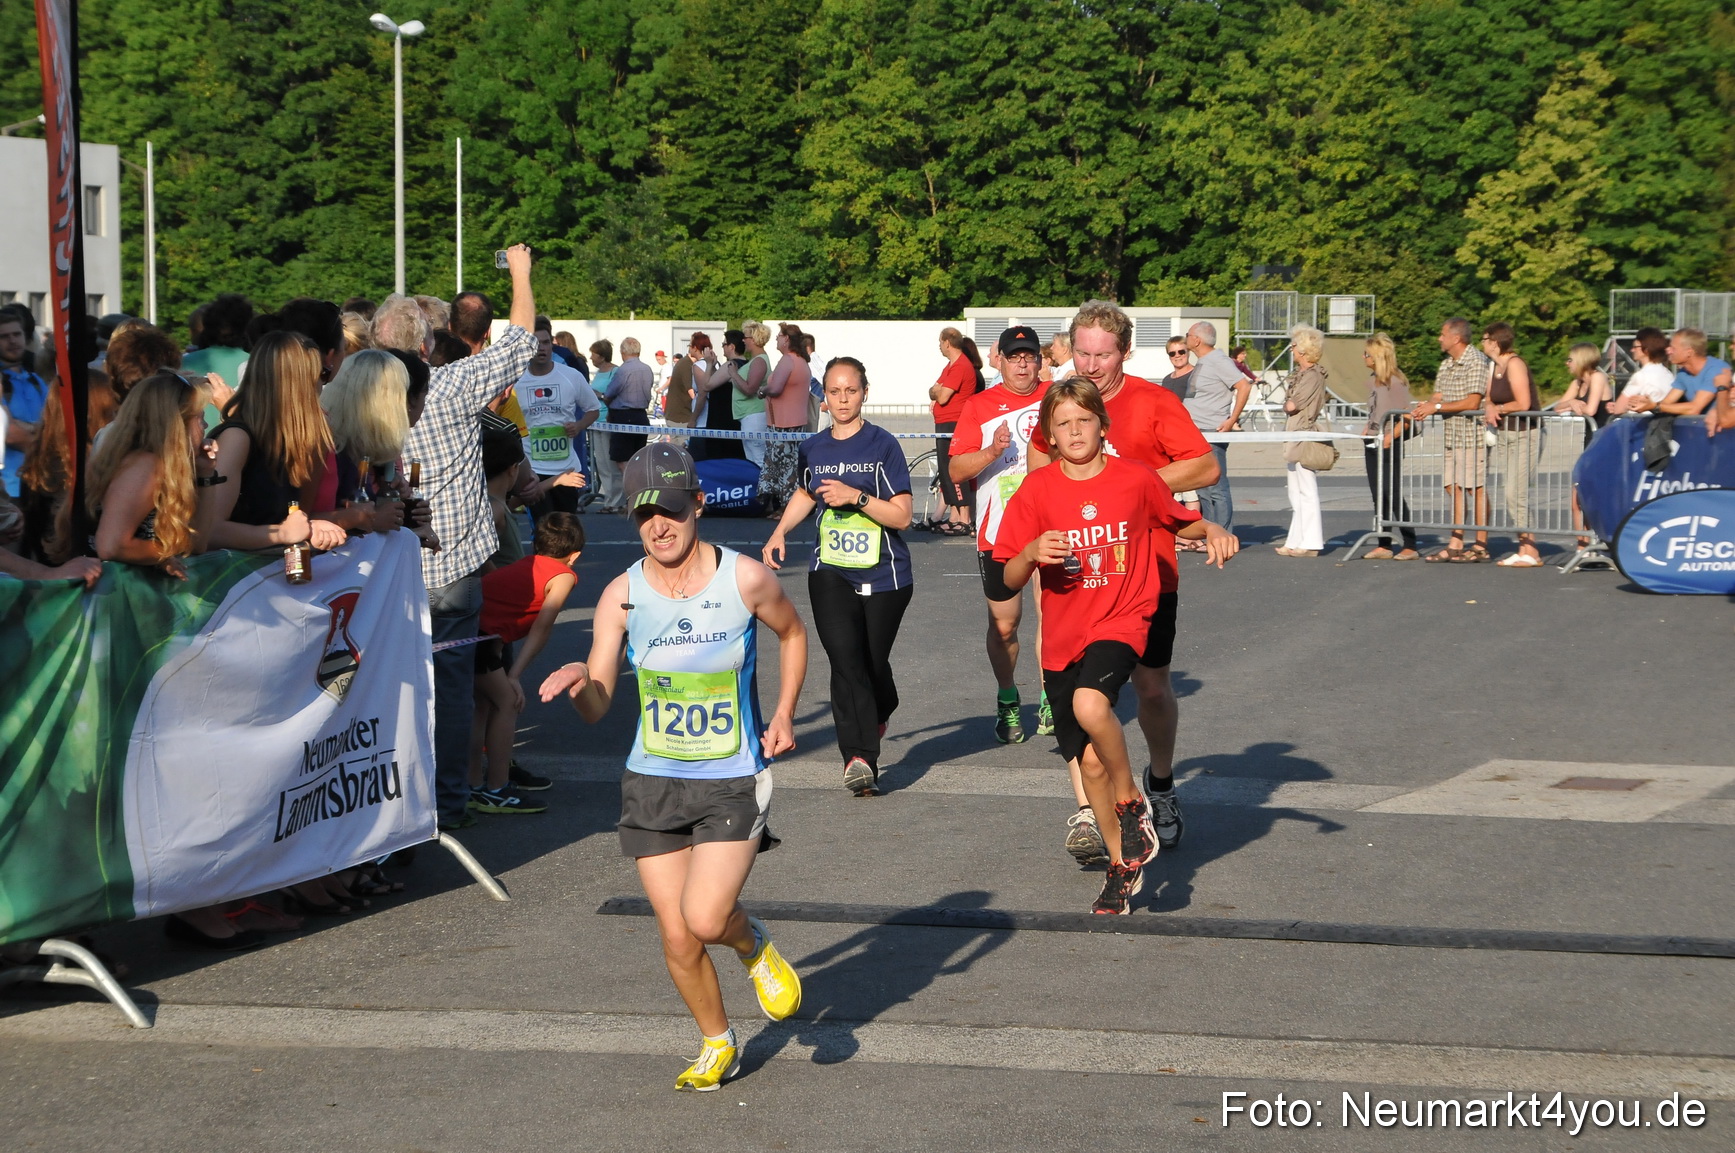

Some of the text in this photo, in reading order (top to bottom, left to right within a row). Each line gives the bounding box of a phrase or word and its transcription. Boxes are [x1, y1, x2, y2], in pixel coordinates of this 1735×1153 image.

[533, 437, 567, 453] 1000
[815, 463, 874, 475] EURO POLES
[828, 529, 870, 554] 368
[1067, 521, 1128, 548] RIPLE
[1666, 537, 1735, 560] Fisc
[1083, 577, 1109, 588] 2013
[648, 631, 727, 648] SCHABMÜLLER
[675, 649, 696, 657] TEAM
[645, 699, 734, 737] 1205
[273, 755, 402, 843] Lammsbräu
